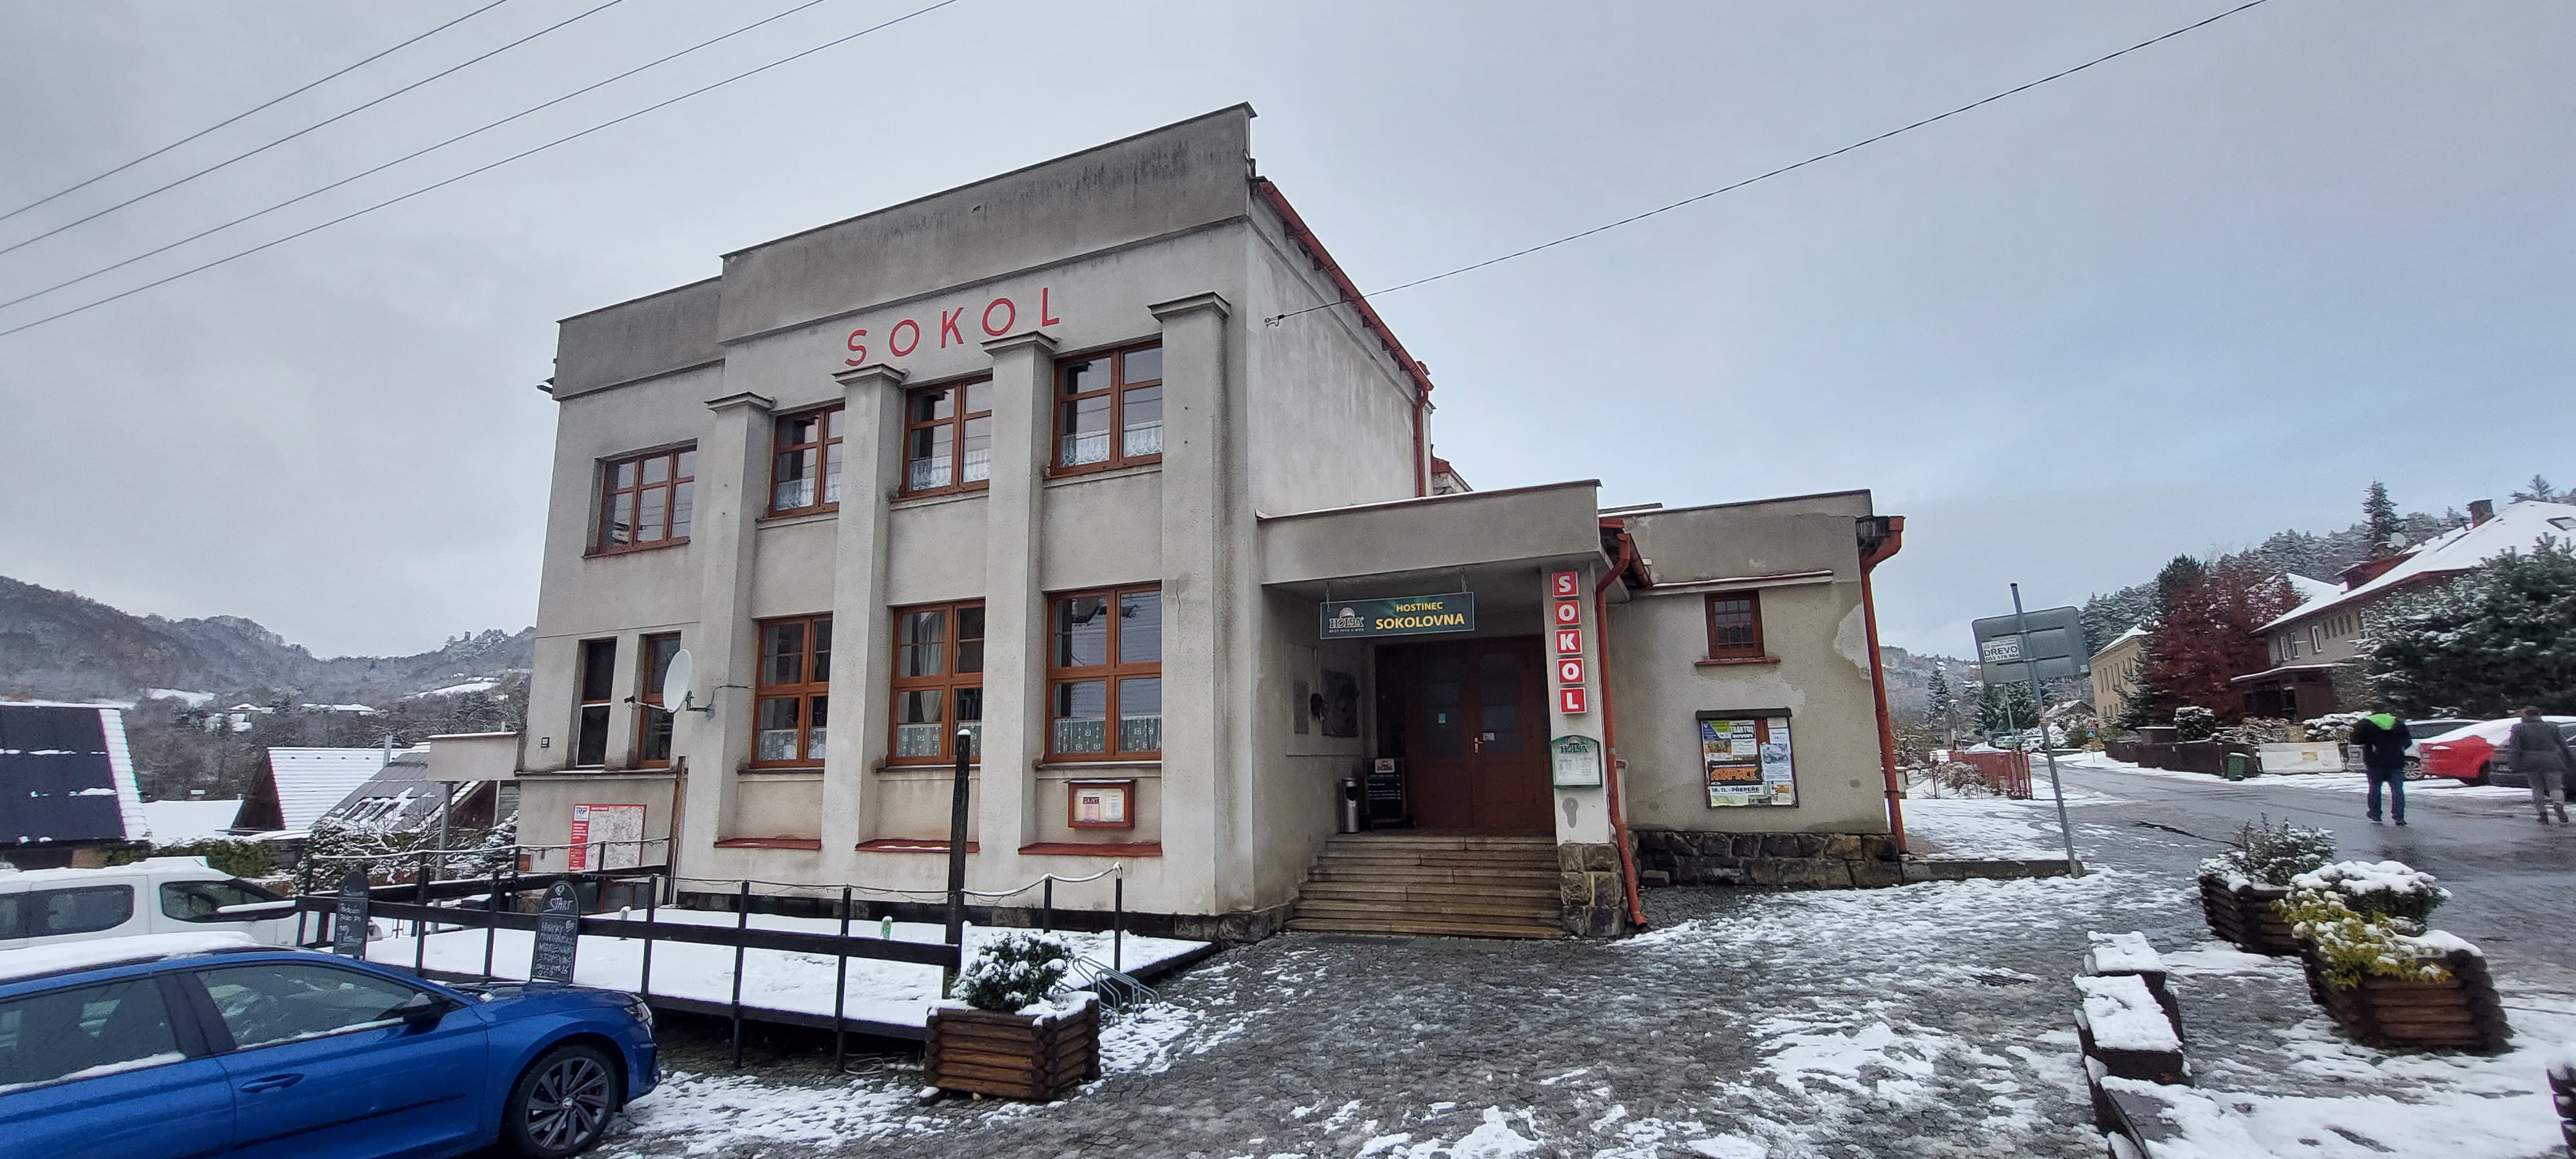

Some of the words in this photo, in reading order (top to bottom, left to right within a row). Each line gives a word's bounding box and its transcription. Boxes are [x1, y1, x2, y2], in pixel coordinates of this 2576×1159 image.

[845, 287, 1059, 366] SOKOL
[1396, 601, 1443, 612] HOSTINEC
[1375, 614, 1465, 630] SOKOLOVNA
[1557, 575, 1580, 710] SOKOL
[1560, 744, 1589, 753] HOLBA
[544, 897, 574, 912] START
